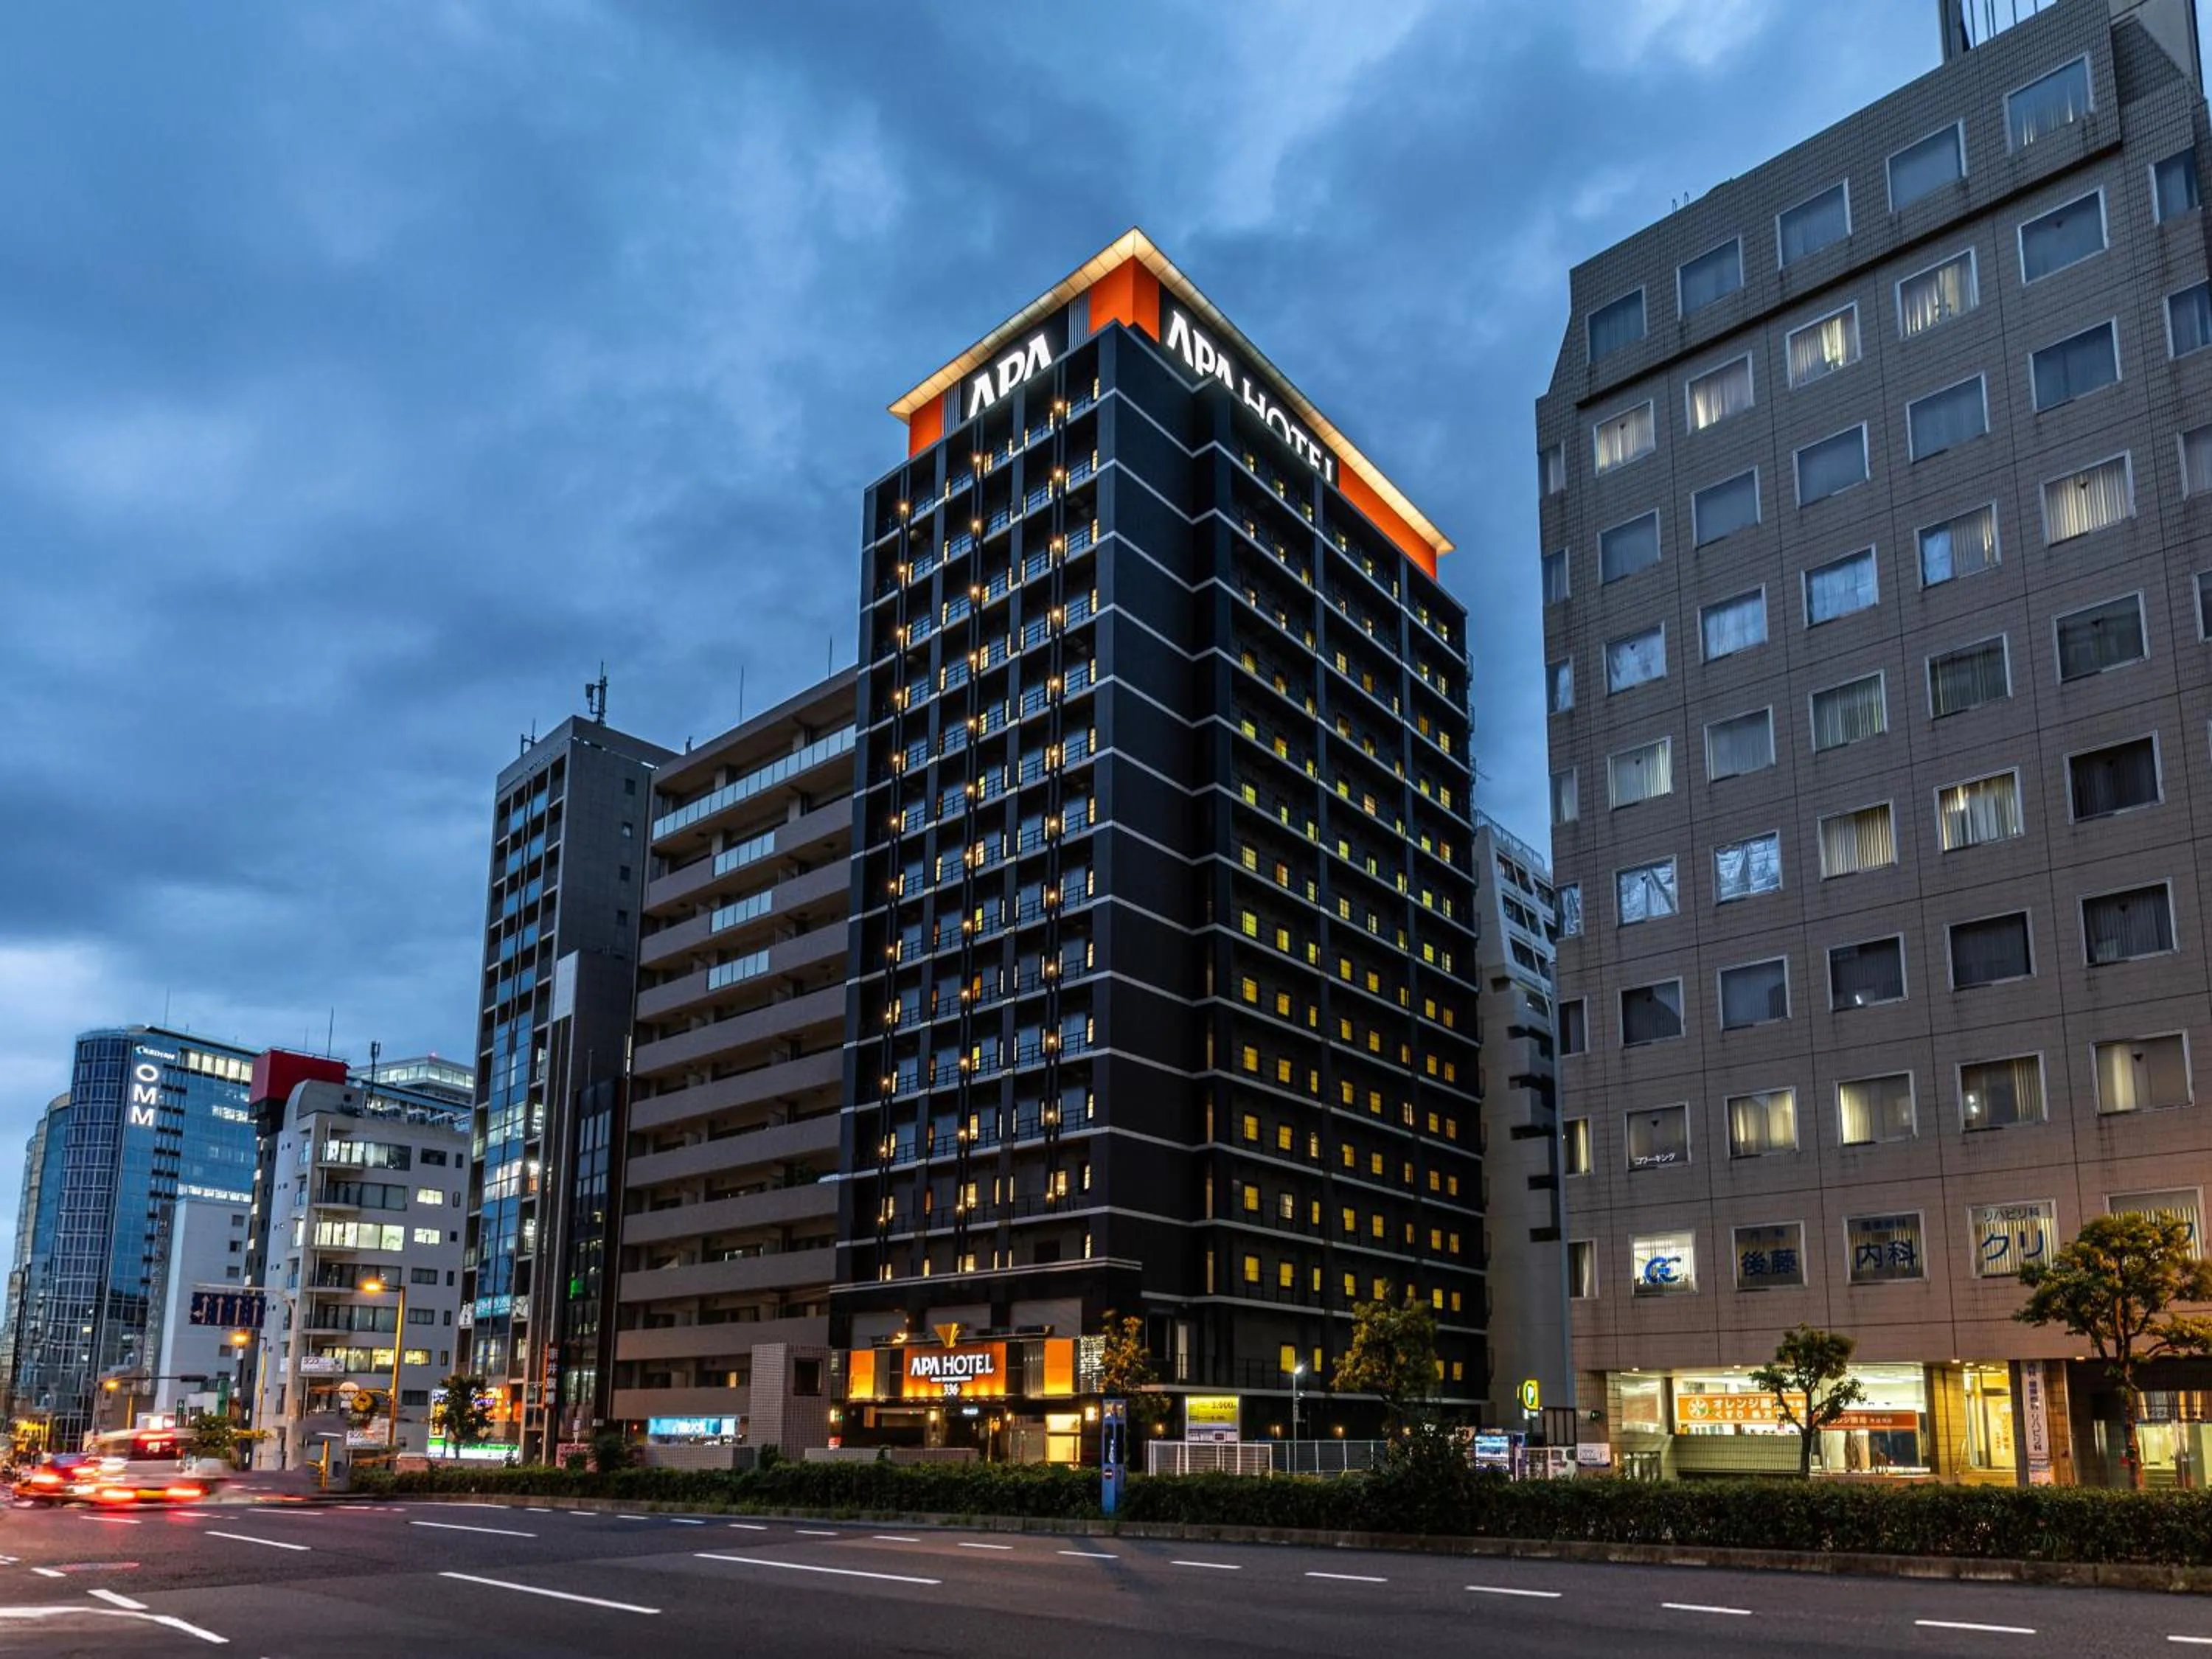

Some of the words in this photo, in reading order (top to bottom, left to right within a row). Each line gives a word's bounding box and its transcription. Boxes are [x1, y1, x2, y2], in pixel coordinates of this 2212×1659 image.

[968, 333, 1052, 419] APA
[1166, 310, 1234, 390] APA
[131, 1063, 159, 1127] OMM
[1741, 1247, 1798, 1276] 後藤
[1856, 1239, 1916, 1270] 内科
[1982, 1229, 2044, 1260] クリ
[911, 1356, 940, 1376] APA
[942, 1354, 994, 1375] HOTEL
